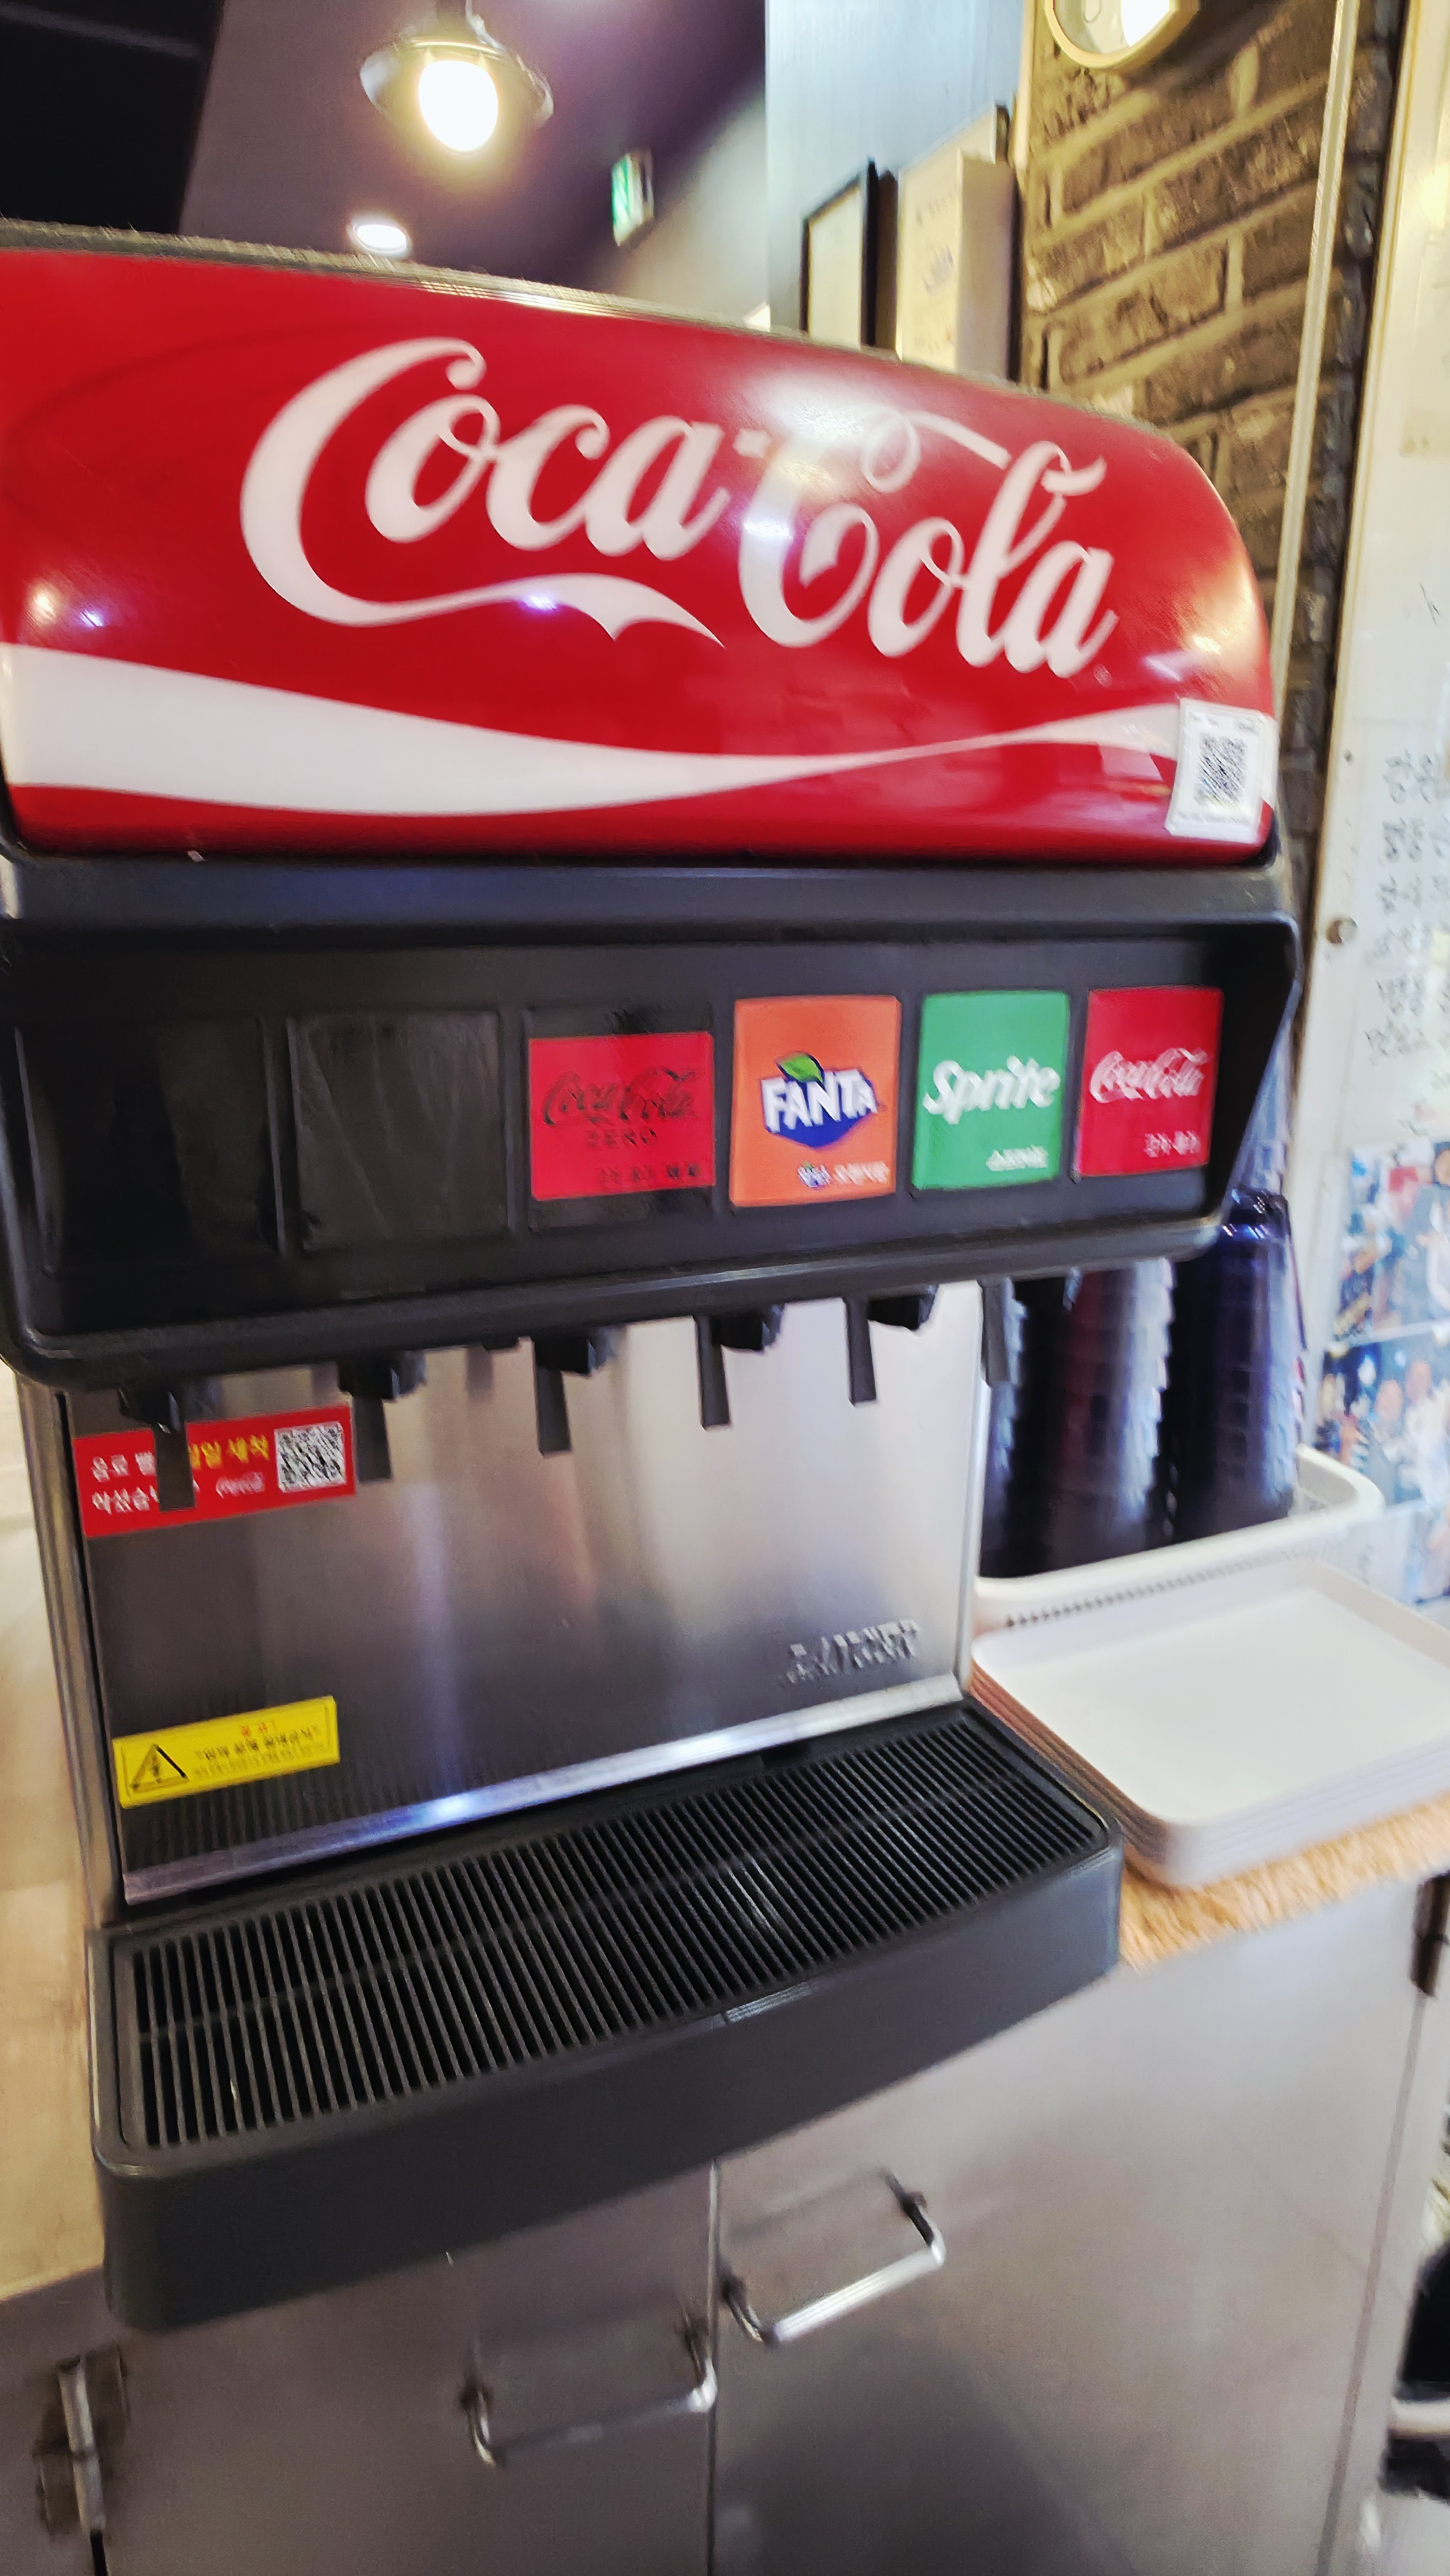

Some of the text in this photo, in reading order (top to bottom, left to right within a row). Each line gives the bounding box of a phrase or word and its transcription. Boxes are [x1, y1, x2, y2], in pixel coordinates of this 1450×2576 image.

[241, 337, 1118, 678] Coca-Cola
[760, 1068, 879, 1134] FANTA
[923, 1055, 1061, 1125] Sprite
[1090, 1048, 1211, 1103] Coca-Cola
